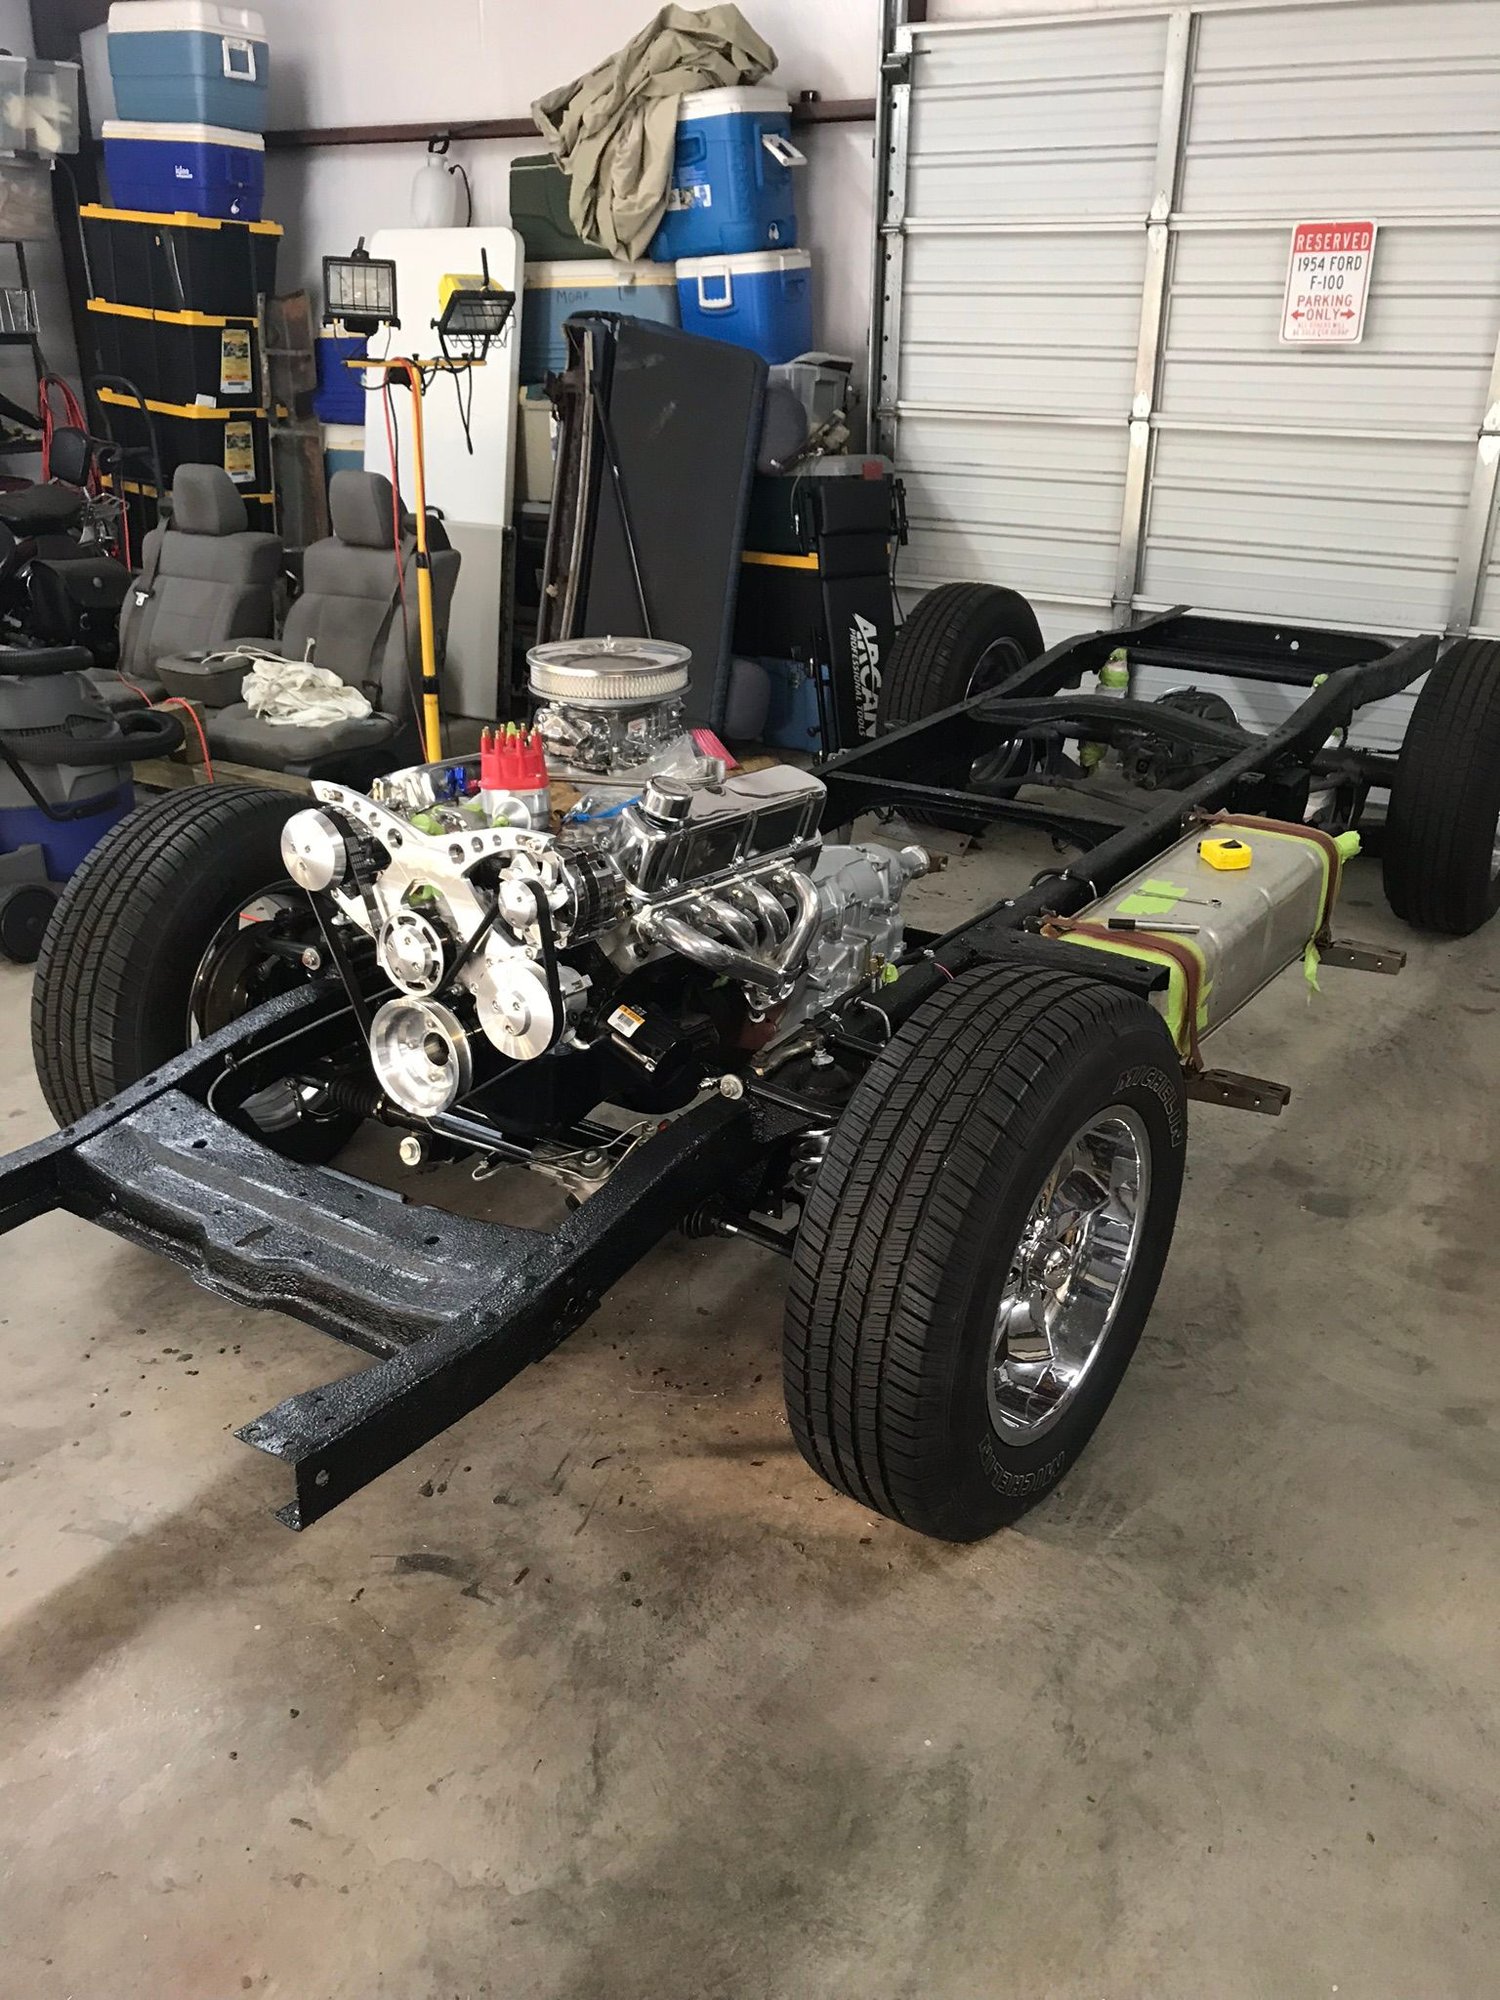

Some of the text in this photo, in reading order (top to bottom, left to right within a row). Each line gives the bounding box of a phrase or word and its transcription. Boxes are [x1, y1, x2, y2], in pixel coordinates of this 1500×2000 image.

[1296, 232, 1370, 250] RESERVED
[1298, 255, 1363, 272] 1954 FORD
[1310, 274, 1345, 290] F-100
[1297, 294, 1353, 308] PARKING
[1306, 308, 1341, 321] ONLY
[849, 626, 867, 737] PROFESSIONAL TOOLS
[852, 612, 882, 738] ARCAN
[1112, 1065, 1182, 1148] MICHELIN
